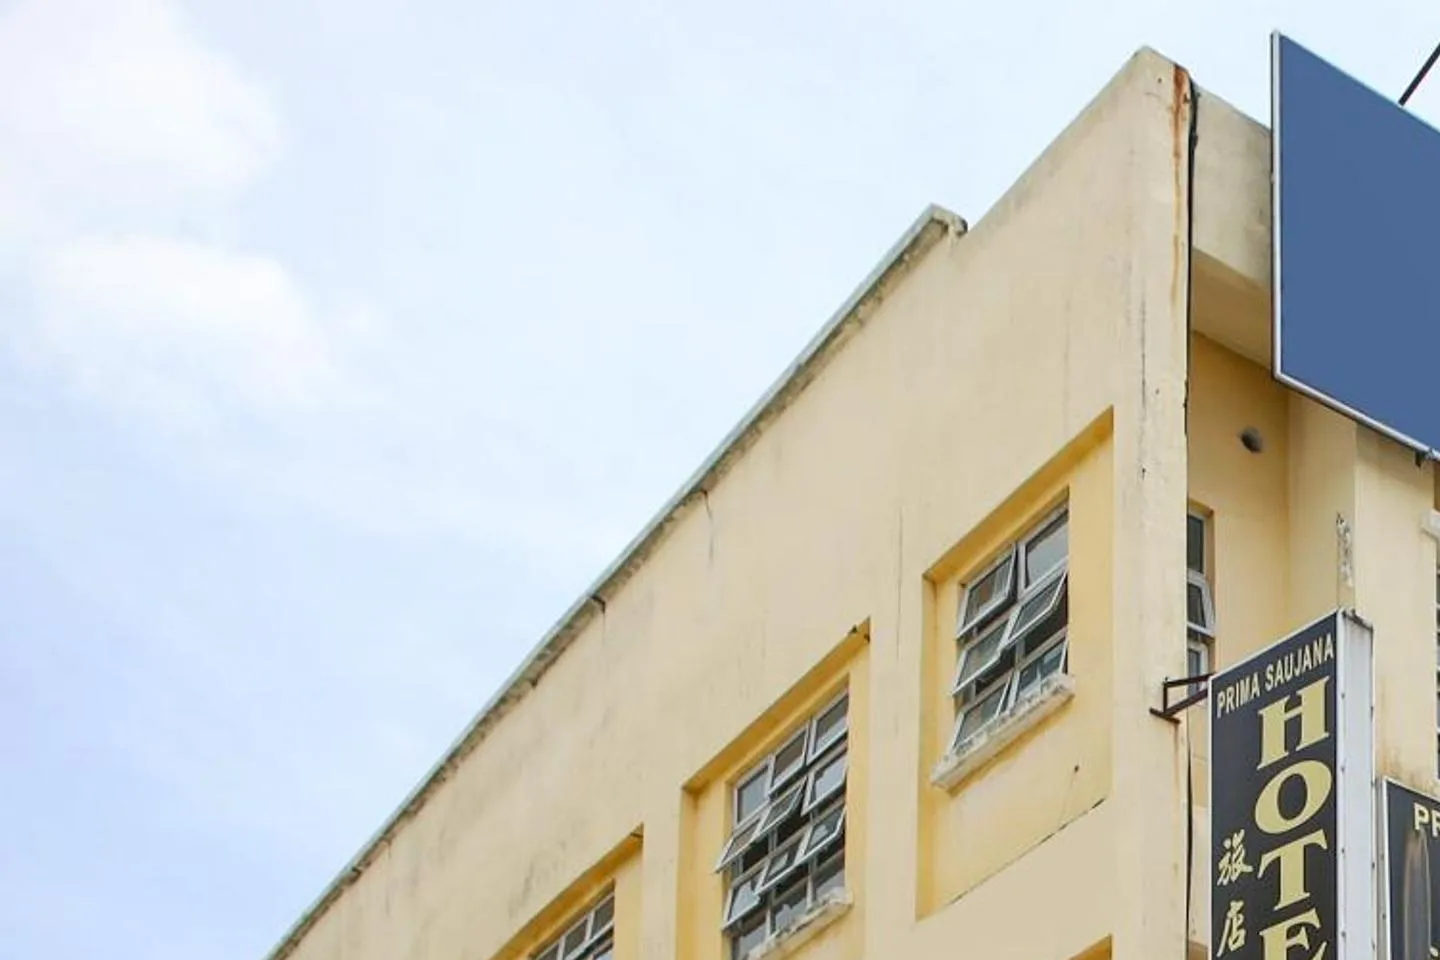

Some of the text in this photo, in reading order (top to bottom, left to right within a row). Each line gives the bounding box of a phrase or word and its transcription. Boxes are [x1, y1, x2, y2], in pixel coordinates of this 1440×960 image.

[1217, 632, 1334, 719] PRIMA SAUJANA
[1216, 829, 1253, 958] 旅店
